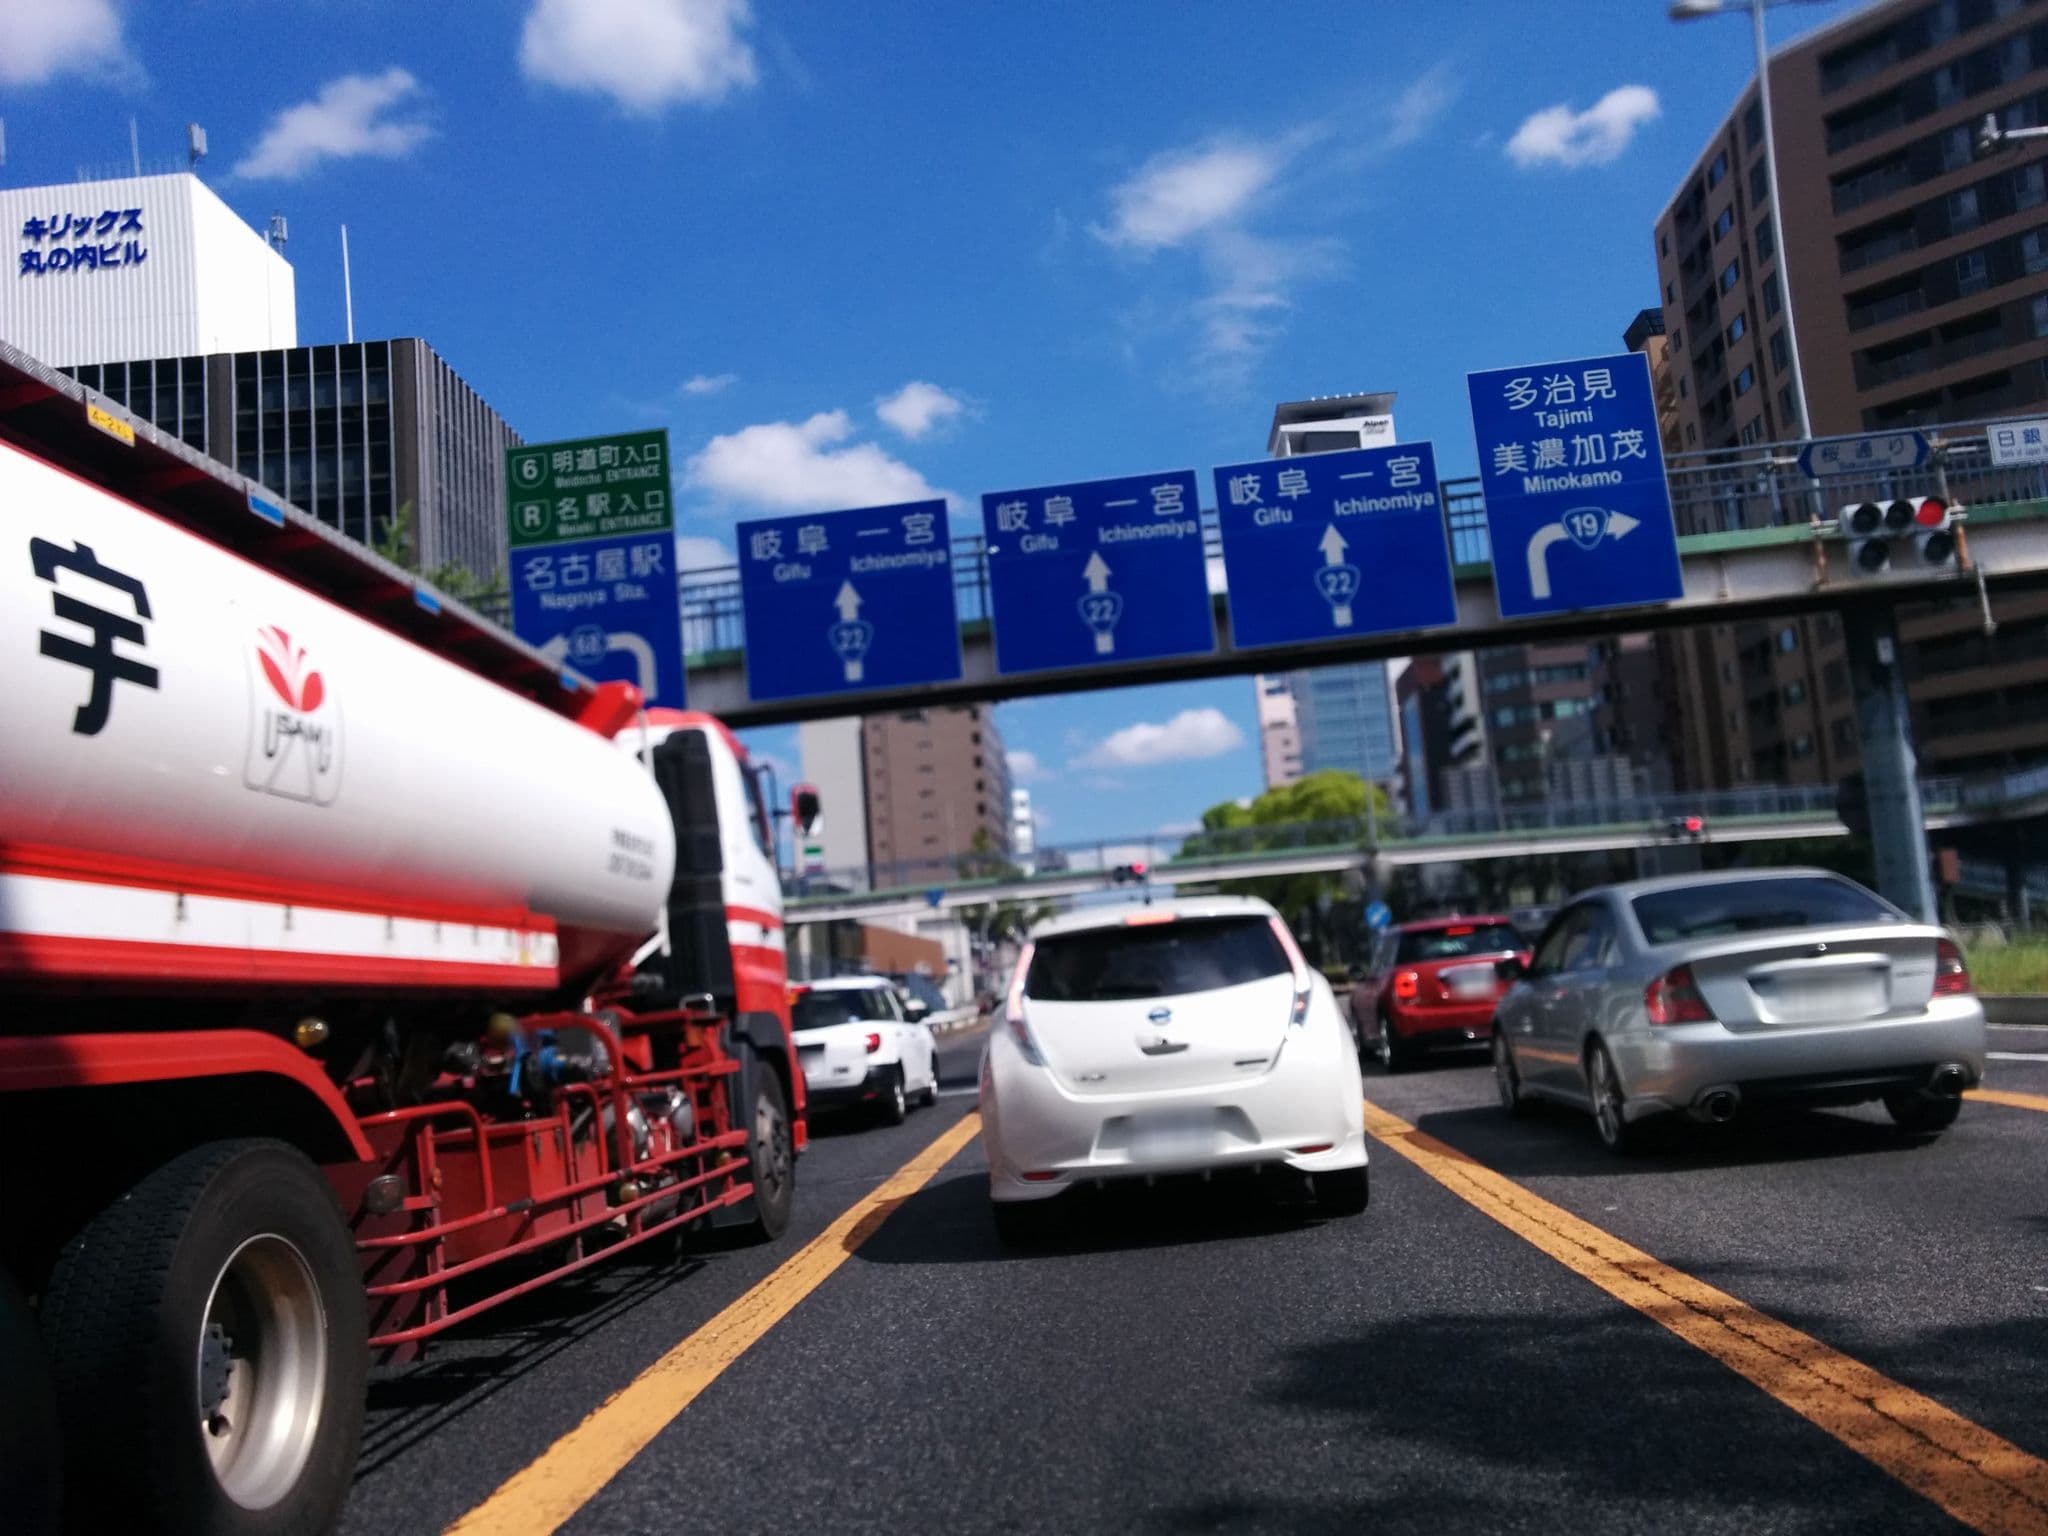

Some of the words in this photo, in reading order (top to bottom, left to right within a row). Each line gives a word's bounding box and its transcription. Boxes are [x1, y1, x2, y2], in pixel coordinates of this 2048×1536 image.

[23, 208, 144, 241] キリックス
[20, 240, 148, 276] 丸の内ビル
[1503, 368, 1617, 410] 多治見
[1534, 406, 1594, 429] Tajimi
[552, 443, 661, 473] 明道町入口
[1493, 428, 1647, 476] 美濃加茂
[521, 459, 538, 480] 6
[1229, 467, 1311, 505] 岐阜
[1339, 455, 1421, 489] 一宮
[1522, 468, 1623, 495] Minokamo
[523, 505, 541, 528] R
[556, 490, 665, 521] 名駅入口
[996, 495, 1077, 532] 岐阜
[1104, 483, 1184, 516] 一宮
[1254, 506, 1293, 526] Gifu
[1334, 490, 1435, 517] Ichinomiya
[751, 524, 830, 561] 岐阜
[856, 512, 935, 545] 一宮
[1020, 533, 1059, 554] Gifu
[1098, 519, 1198, 544] Ichinomiya
[1570, 513, 1599, 538] 19
[523, 543, 666, 591] 名古屋駅
[773, 562, 812, 582] Gifu
[850, 549, 947, 573] Ichinomiya
[540, 588, 608, 612] Nagoya
[1325, 572, 1352, 595] 22
[1087, 600, 1115, 623] 22
[29, 536, 161, 737] 宇
[839, 627, 865, 650] 22
